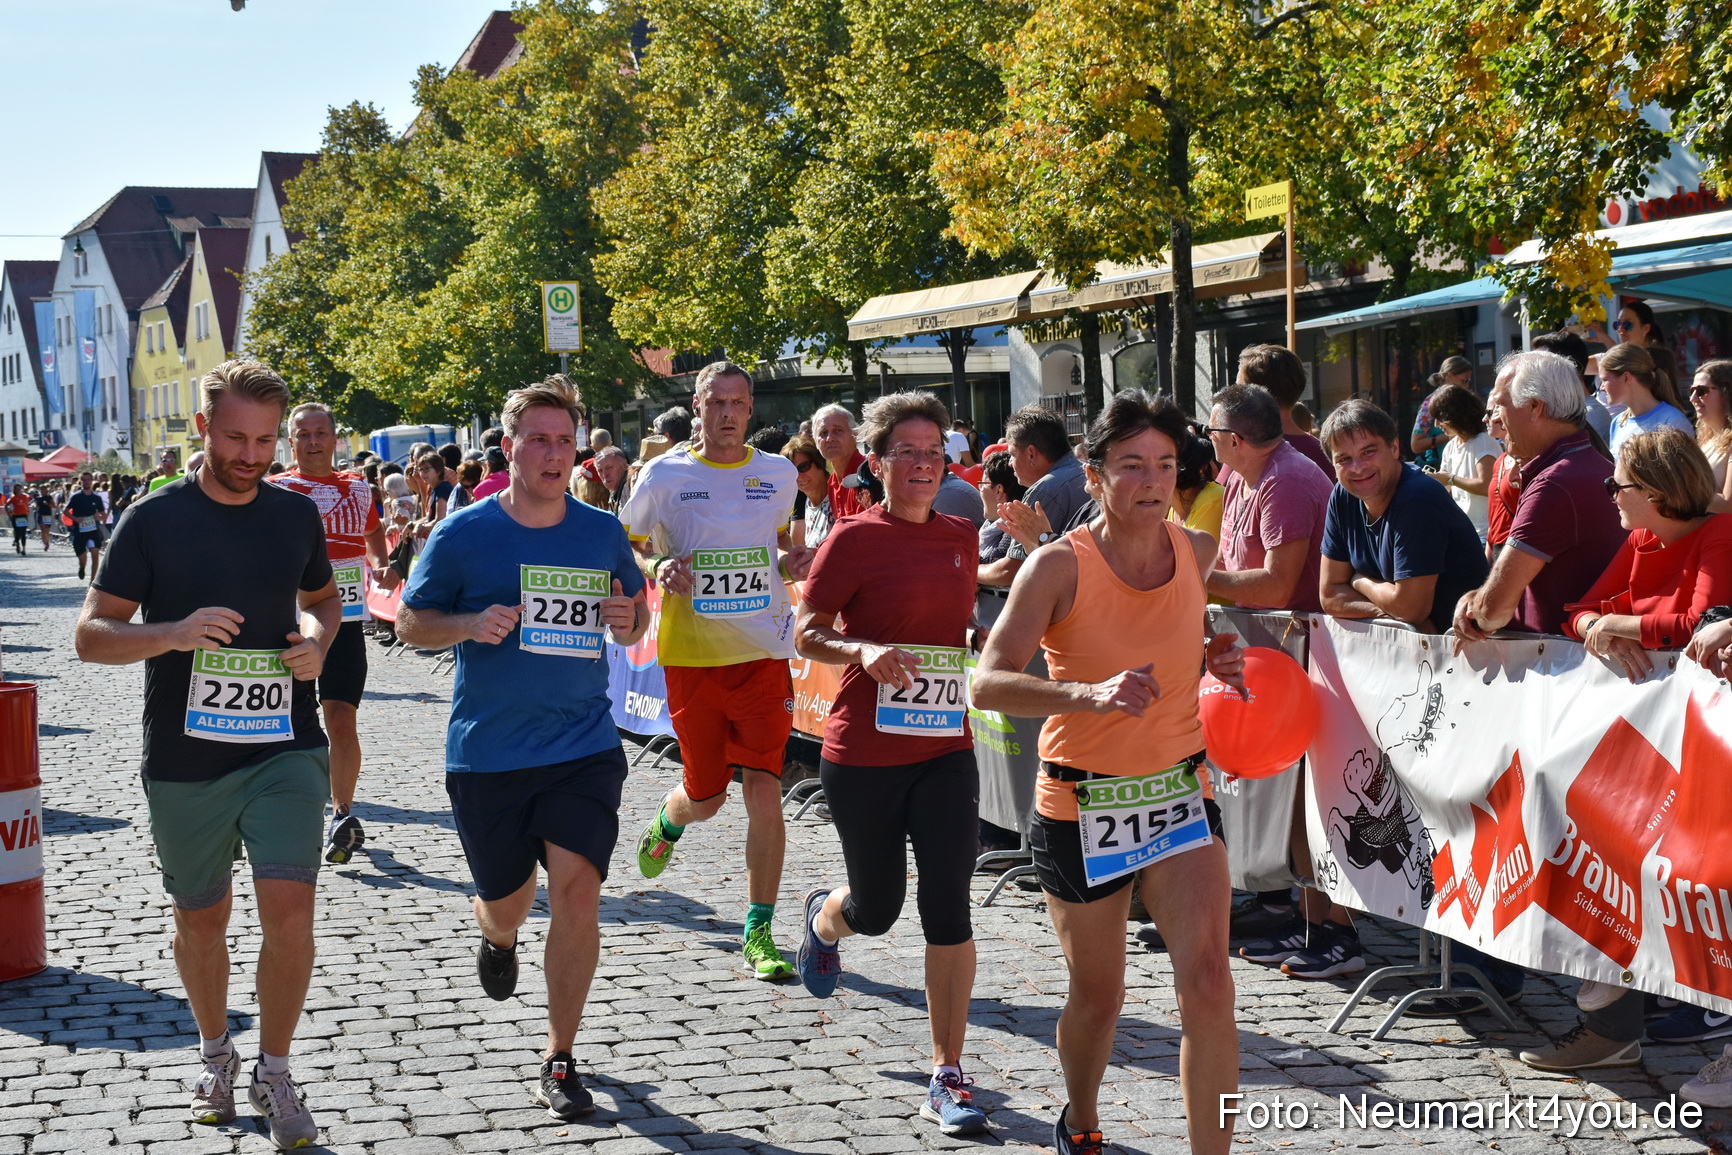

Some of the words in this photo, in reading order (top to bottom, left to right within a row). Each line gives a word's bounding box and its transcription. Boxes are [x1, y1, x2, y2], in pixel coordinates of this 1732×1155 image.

[1254, 194, 1287, 210] Toiletten
[1639, 182, 1728, 221] vodafo
[745, 478, 759, 487] 20
[697, 549, 764, 567] BOCK
[334, 568, 357, 582] CK
[528, 569, 605, 593] BOCK
[701, 571, 762, 595] 2124
[532, 597, 601, 627] 2281
[700, 599, 764, 611] CHRISTIAN
[530, 631, 598, 647] CHRISTIAN
[202, 650, 286, 674] BOCK
[911, 650, 961, 670] OCK
[201, 680, 282, 711] 2280
[890, 677, 959, 705] 2270
[196, 715, 280, 730] ALEXANDER
[903, 712, 948, 726] KATJA
[1088, 767, 1191, 806] BOCK
[1647, 812, 1663, 832] Seit
[1661, 789, 1677, 813] 1929
[1095, 803, 1189, 848] 2153
[1125, 837, 1171, 866] ELKE
[1550, 817, 1636, 924] Braun
[1503, 892, 1517, 908] Sicher
[1652, 853, 1732, 942] Brau
[1573, 891, 1603, 919] Sicher
[1602, 911, 1615, 928] ist
[1614, 922, 1641, 948] sicher
[1709, 947, 1732, 969] Sich
